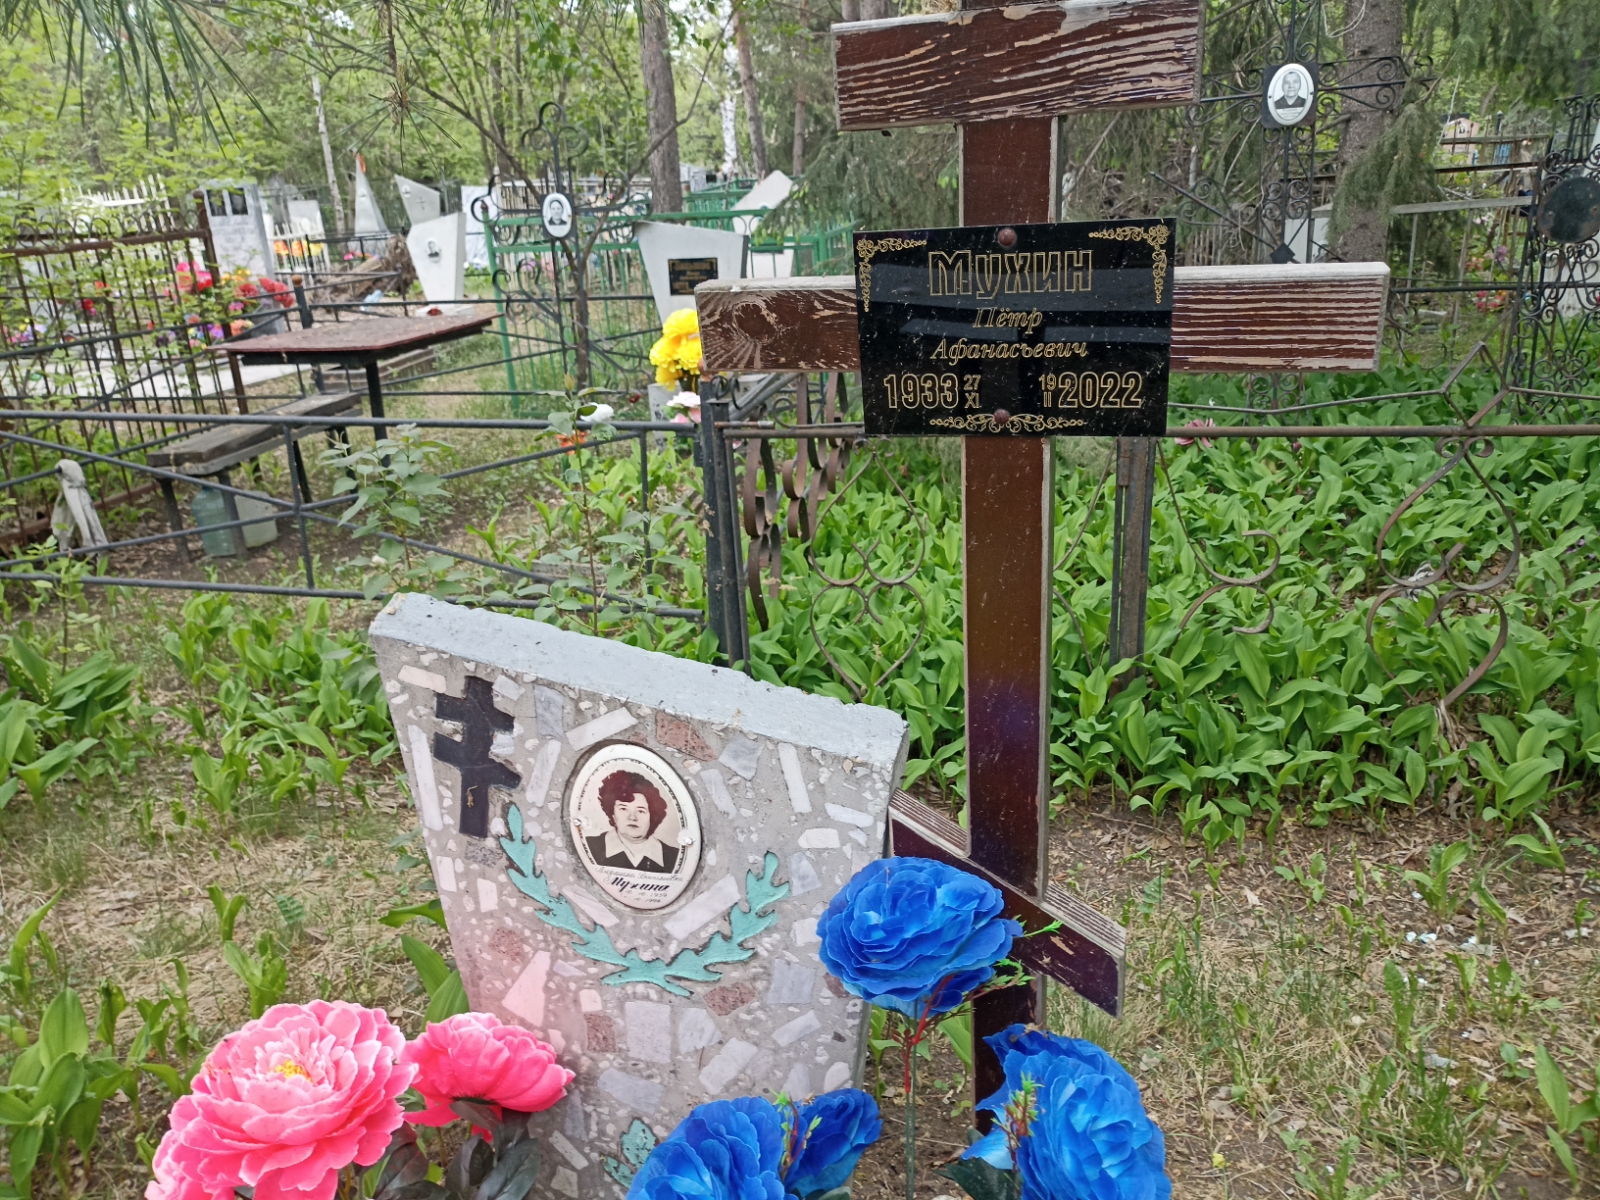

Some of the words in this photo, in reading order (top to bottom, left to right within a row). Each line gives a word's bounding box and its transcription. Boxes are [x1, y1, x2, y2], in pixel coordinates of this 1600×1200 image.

[972, 305, 1043, 335] Пётр
[929, 337, 1090, 366] Афанасьевич
[883, 372, 959, 409] 1933
[963, 374, 982, 391] 27
[1038, 374, 1057, 391] 19
[1058, 371, 1143, 409] 2022
